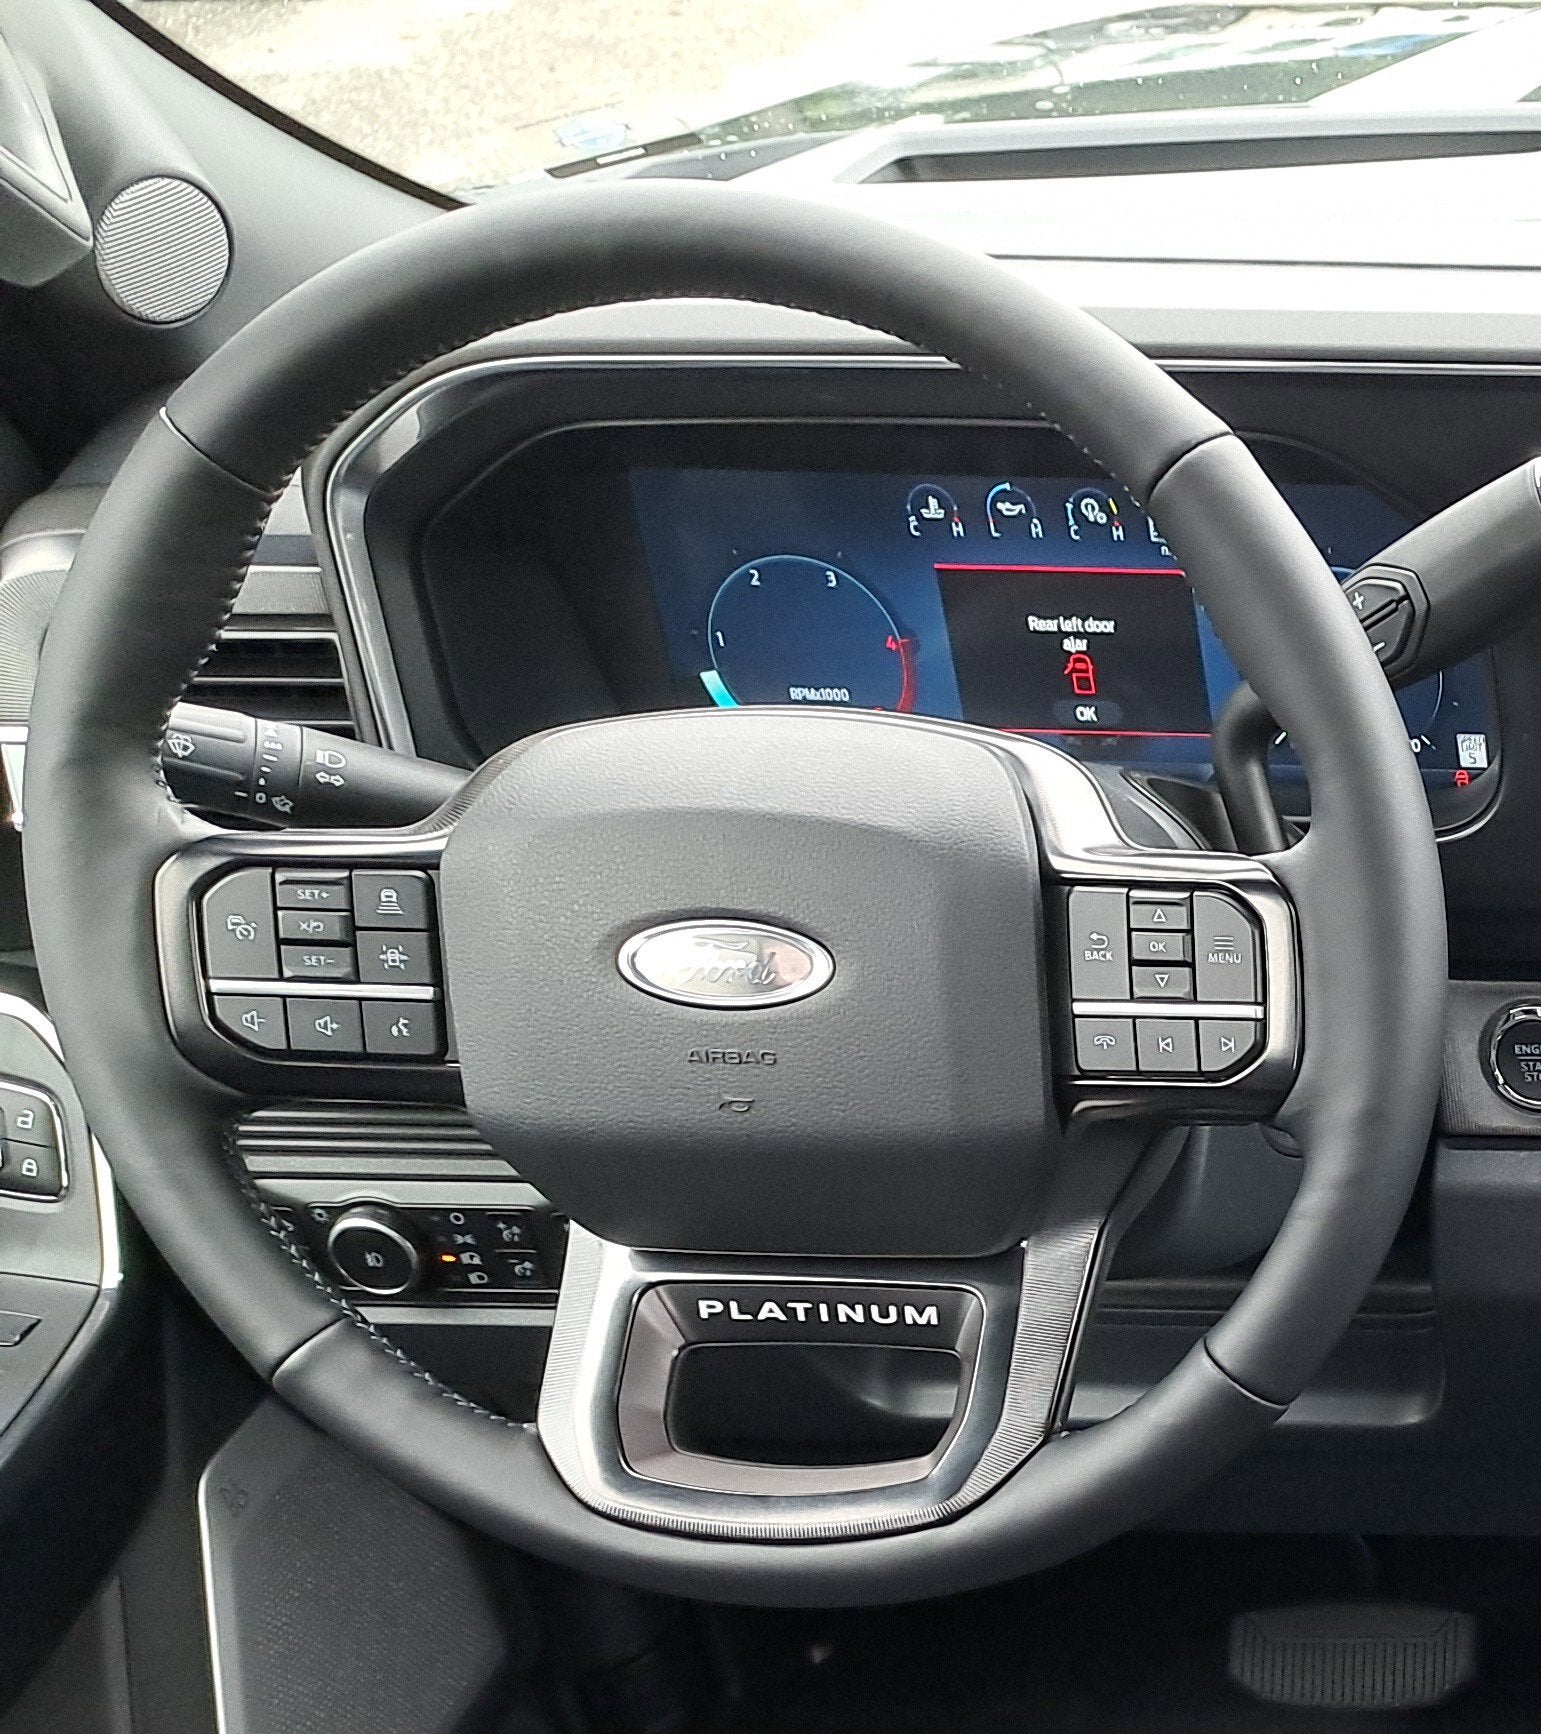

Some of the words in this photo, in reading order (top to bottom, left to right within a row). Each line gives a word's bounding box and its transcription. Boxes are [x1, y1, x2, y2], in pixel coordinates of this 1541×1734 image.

[951, 521, 965, 538] H
[1069, 524, 1081, 540] C
[1112, 526, 1124, 541] H
[749, 569, 761, 586] 2
[825, 570, 838, 588] 3
[1027, 615, 1058, 632] Rear
[1059, 615, 1084, 632] left
[1085, 616, 1115, 633] door
[715, 630, 725, 648] 1
[885, 634, 898, 651] 4
[1062, 636, 1087, 653] ajar
[1075, 706, 1098, 722] OK
[1149, 941, 1167, 953] OK
[1084, 949, 1114, 963] BACK
[1207, 952, 1242, 965] MENU
[687, 1048, 778, 1066] AIRBAG
[697, 1298, 940, 1326] PLATINUM
